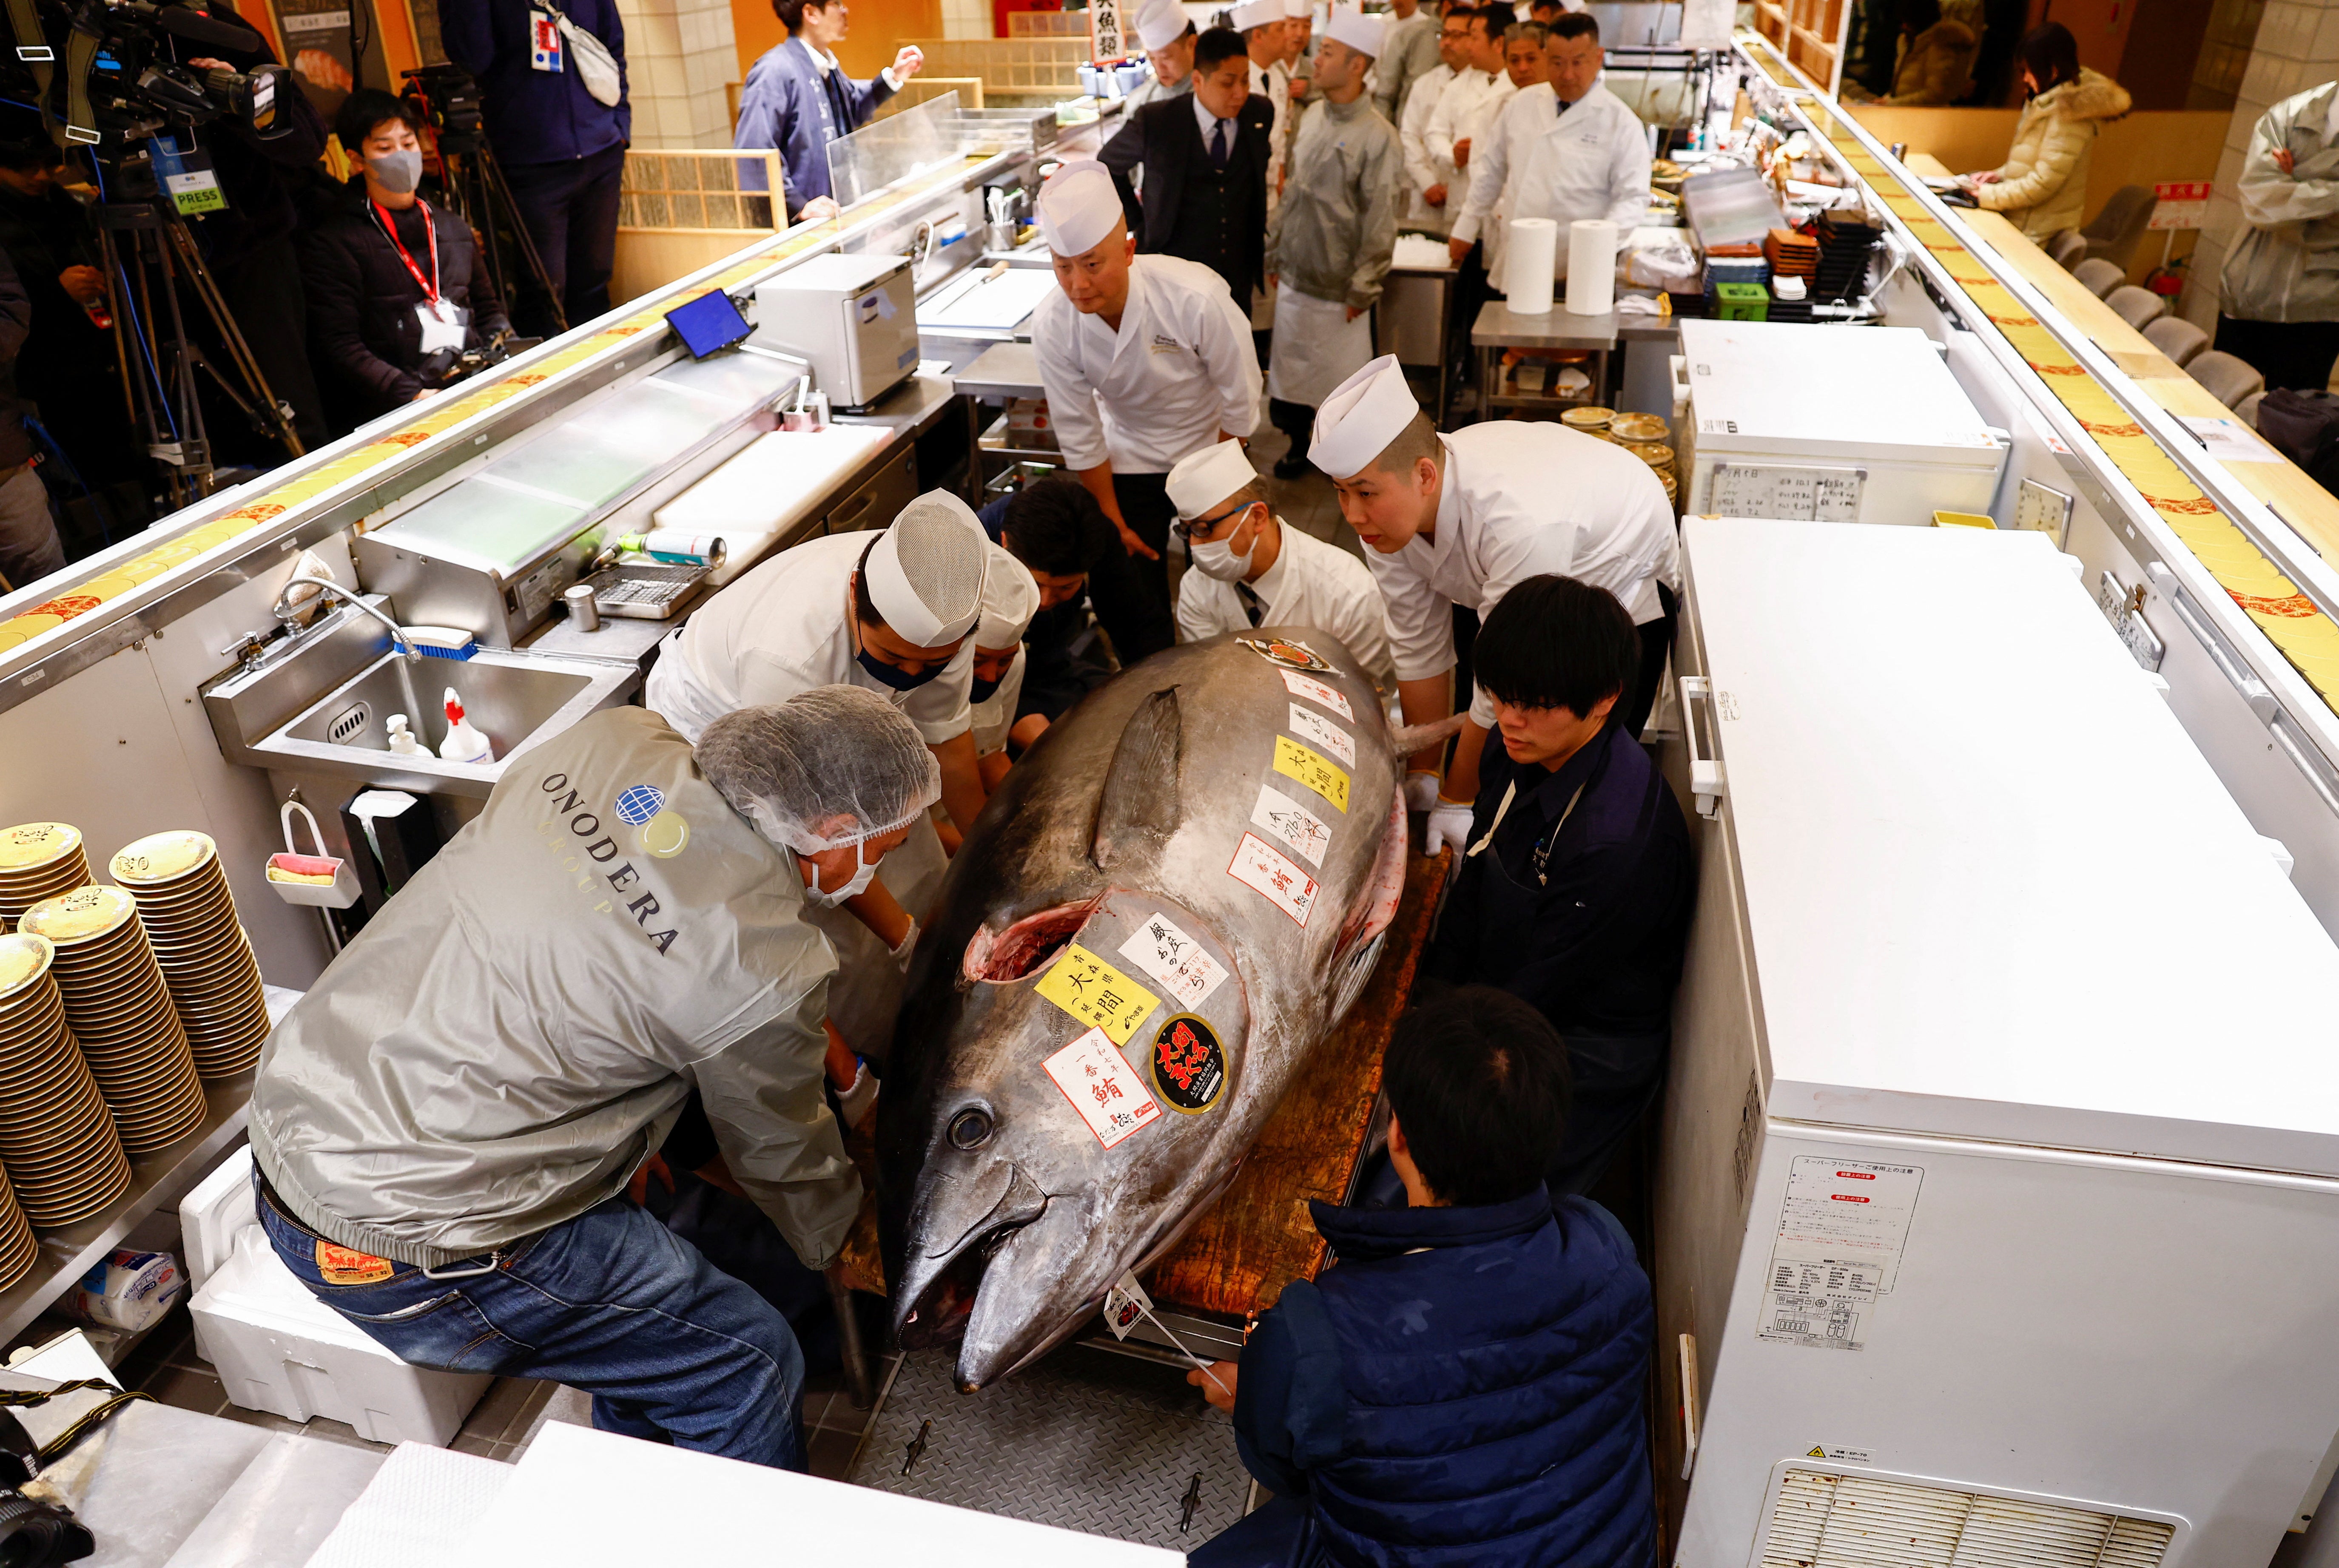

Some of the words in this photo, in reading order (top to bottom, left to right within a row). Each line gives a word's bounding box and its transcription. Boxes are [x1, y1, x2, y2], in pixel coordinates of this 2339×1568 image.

[177, 190, 218, 205] PRESS
[26, 673, 40, 682] C34
[1289, 756, 1332, 787] 大間
[538, 821, 613, 913] GROUP
[542, 773, 679, 957] ONODERA
[1249, 856, 1293, 895] 一番鮪
[1073, 954, 1114, 984] 青森県
[1068, 973, 1125, 1015] 大間
[1129, 1004, 1144, 1020] やま幸
[1090, 1039, 1119, 1073] 令和七年
[1157, 1021, 1195, 1073] 大間
[1076, 1054, 1124, 1109] 一番鮪
[1099, 1124, 1116, 1139] なだ万
[1123, 1121, 1142, 1135] ONODERA
[1804, 1159, 1914, 1174] スーパーフリーザーご使用上の注意
[22, 1454, 39, 1478] Nikon
